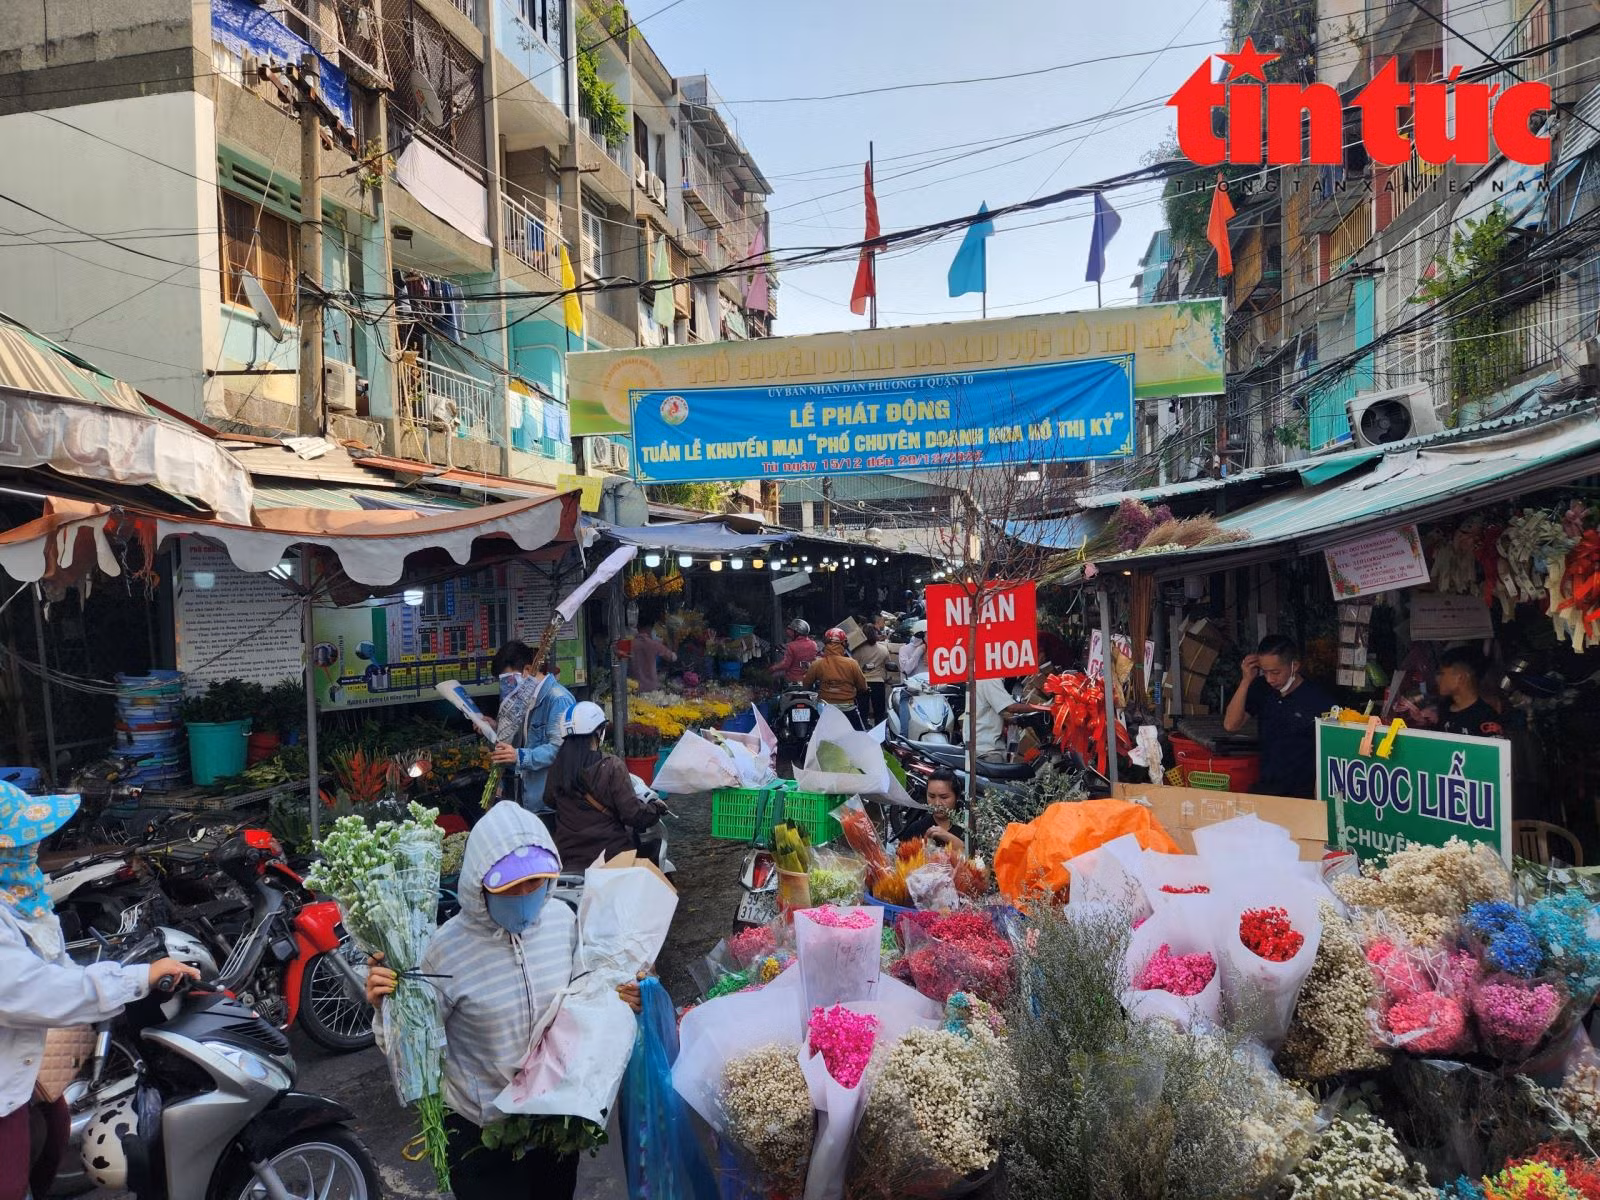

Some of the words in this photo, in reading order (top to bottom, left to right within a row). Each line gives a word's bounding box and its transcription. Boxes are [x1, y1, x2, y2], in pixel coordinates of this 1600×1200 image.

[822, 401, 880, 426] PHÁT
[886, 398, 950, 426] ĐỘNG
[854, 428, 920, 451] CHUYÊN
[822, 457, 862, 470] 15/12
[985, 639, 1035, 671] HOA
[1327, 755, 1412, 822] NGỌC
[1417, 749, 1495, 831] LIỄU
